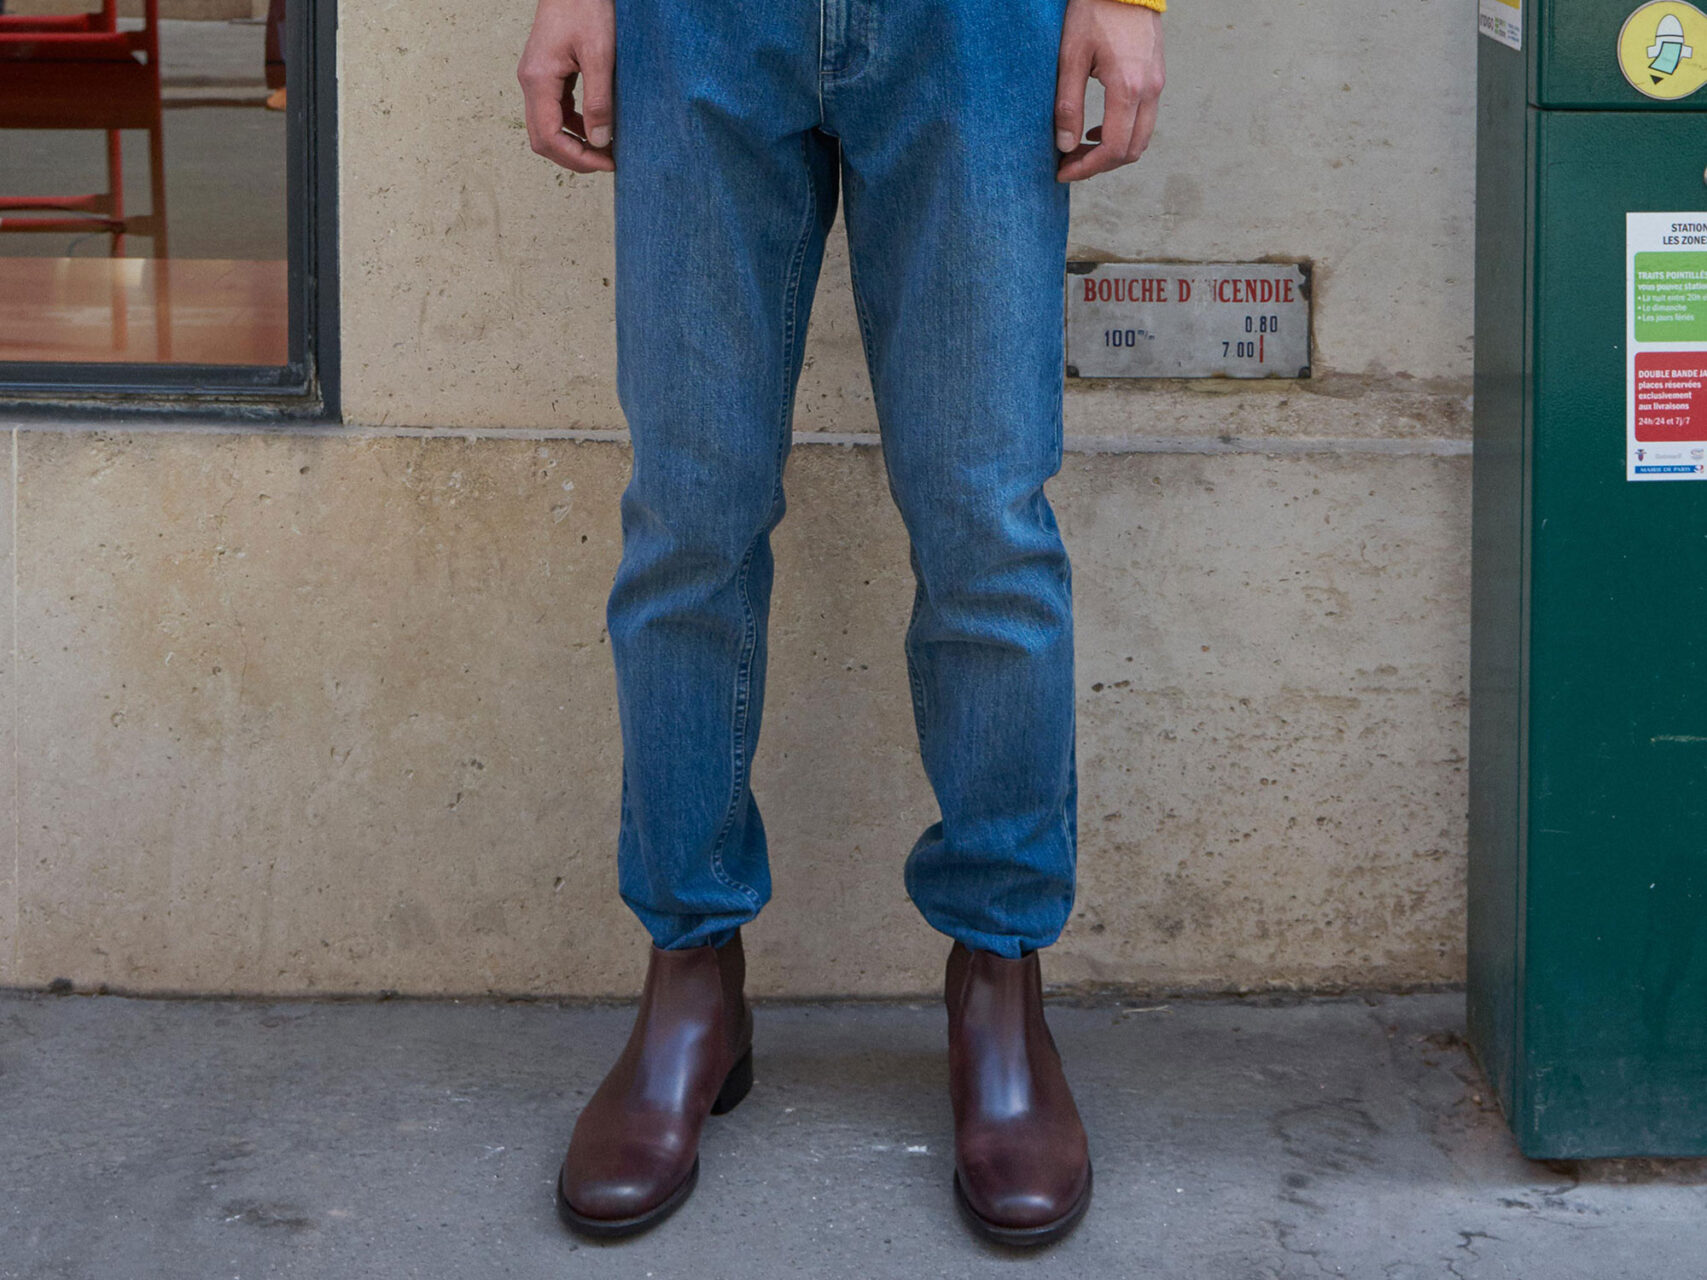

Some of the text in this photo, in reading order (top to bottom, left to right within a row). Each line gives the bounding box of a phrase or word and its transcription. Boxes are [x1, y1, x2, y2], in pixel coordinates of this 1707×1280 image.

[1663, 236, 1707, 245] LES ZONE
[1638, 271, 1664, 280] TRAITS
[1083, 277, 1168, 303] BOUCHE
[1245, 315, 1278, 333] 0.80
[1638, 369, 1670, 378] DOUBLE
[1672, 369, 1698, 378] BANDE
[1638, 380, 1702, 391] places réservées
[1638, 392, 1692, 400] exclusivement
[1638, 402, 1690, 411] aux livraisons
